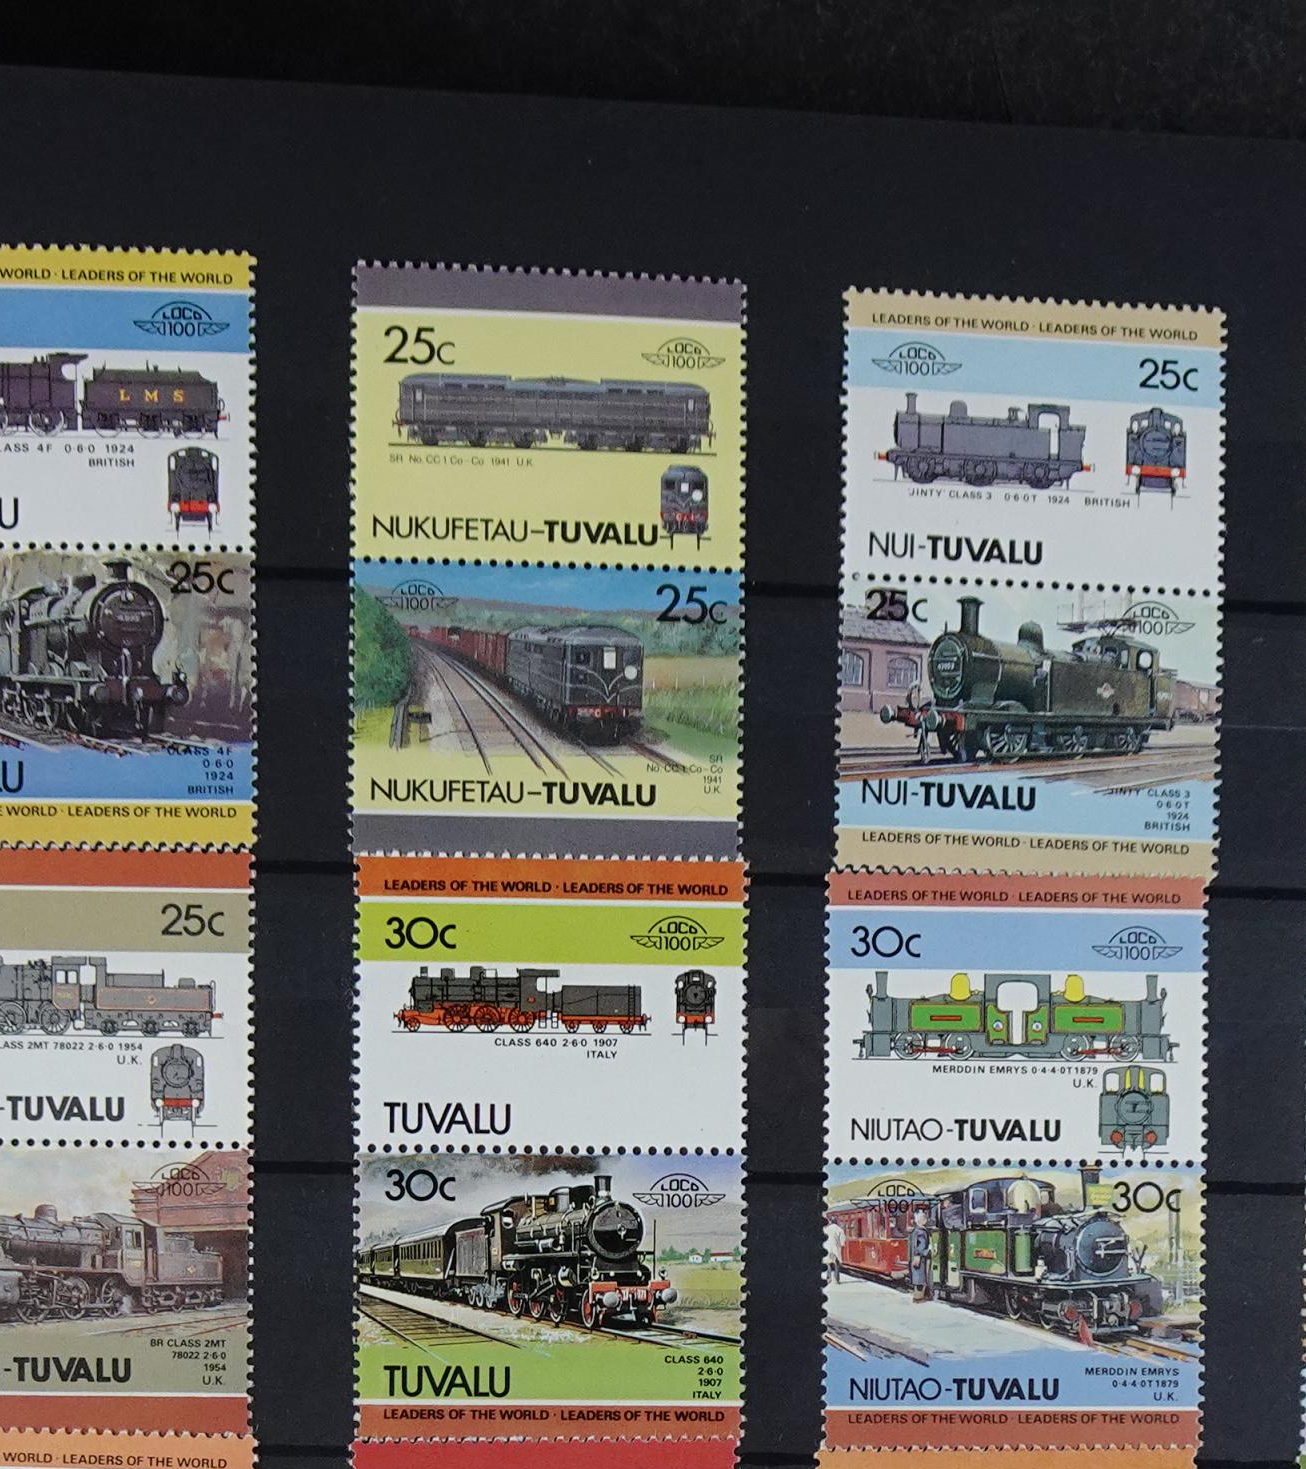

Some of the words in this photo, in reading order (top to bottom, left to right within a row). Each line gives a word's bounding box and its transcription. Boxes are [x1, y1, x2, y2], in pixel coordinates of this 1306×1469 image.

[0, 267, 51, 280] WORLD
[61, 269, 125, 282] LEADERS
[128, 271, 146, 283] OF
[149, 271, 176, 284] THE
[180, 272, 233, 285] WORLD
[383, 325, 456, 366] 25c
[1139, 358, 1198, 392] 25c
[37, 443, 53, 454] 4F
[105, 444, 135, 454] 1924
[88, 458, 135, 468] BRITISH
[1047, 495, 1070, 505] 1924
[1084, 497, 1131, 508] BRITISH
[169, 561, 235, 595] 25c
[655, 583, 728, 625] 25c
[865, 588, 928, 623] 25c
[187, 785, 235, 795] BRITISH
[1144, 821, 1191, 832] BRITISH
[384, 880, 447, 891] LEADERS
[450, 880, 468, 892] OF
[471, 881, 498, 892] THE
[501, 881, 552, 893] WORLD
[563, 882, 624, 894] LEADERS
[627, 883, 645, 895] OF
[648, 883, 674, 895] THE
[677, 884, 729, 896] WORLD
[160, 904, 225, 937] 25c
[385, 917, 457, 949] 30c
[851, 926, 922, 959] 30c
[27, 1041, 49, 1050] 2MT
[53, 1041, 84, 1051] 78022
[118, 1042, 143, 1052] 1954
[494, 1038, 532, 1048] CLASS
[535, 1038, 558, 1048] 640
[593, 1038, 618, 1047] 1907
[586, 1050, 617, 1059] ITALY
[932, 1064, 986, 1075] MERDDIN
[989, 1065, 1028, 1075] EMRYS
[383, 1102, 512, 1136] TUVALU
[385, 1169, 456, 1202] 30c
[1111, 1181, 1183, 1213] 30c
[203, 1363, 227, 1372] 1954
[664, 1355, 700, 1365] CLASS
[703, 1355, 724, 1365] 640
[383, 1365, 512, 1398] TUVALU
[692, 1390, 723, 1400] ITALY
